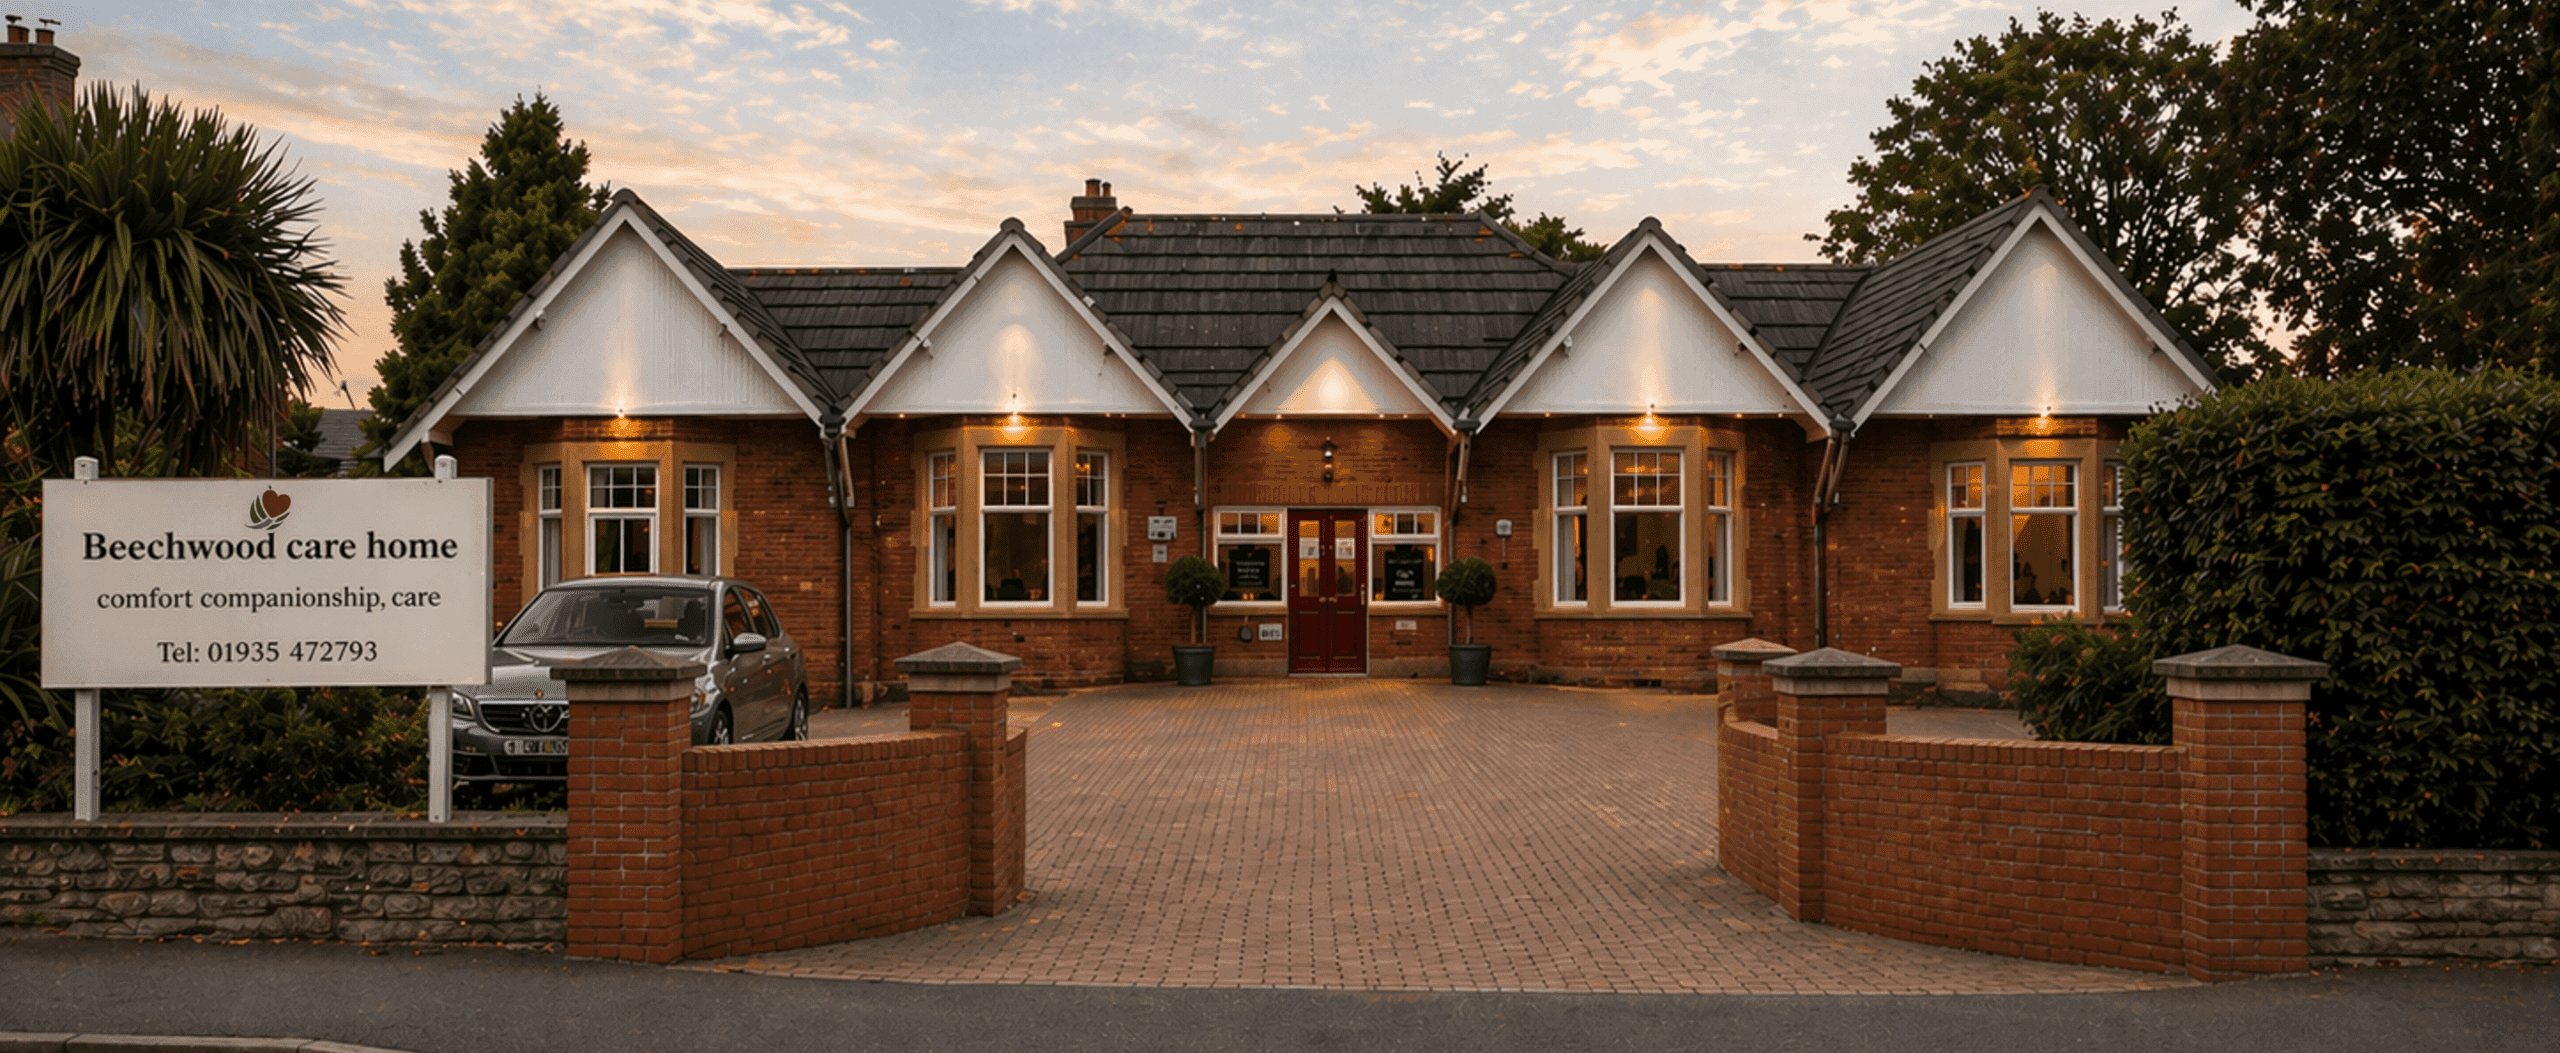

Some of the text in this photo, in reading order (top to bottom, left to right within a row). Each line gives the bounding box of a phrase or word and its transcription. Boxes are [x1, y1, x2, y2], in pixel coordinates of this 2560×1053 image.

[82, 530, 458, 561] Beechwood care home
[96, 586, 441, 613] comfort companionship, care
[156, 640, 378, 664] Tel: 01935 472793
